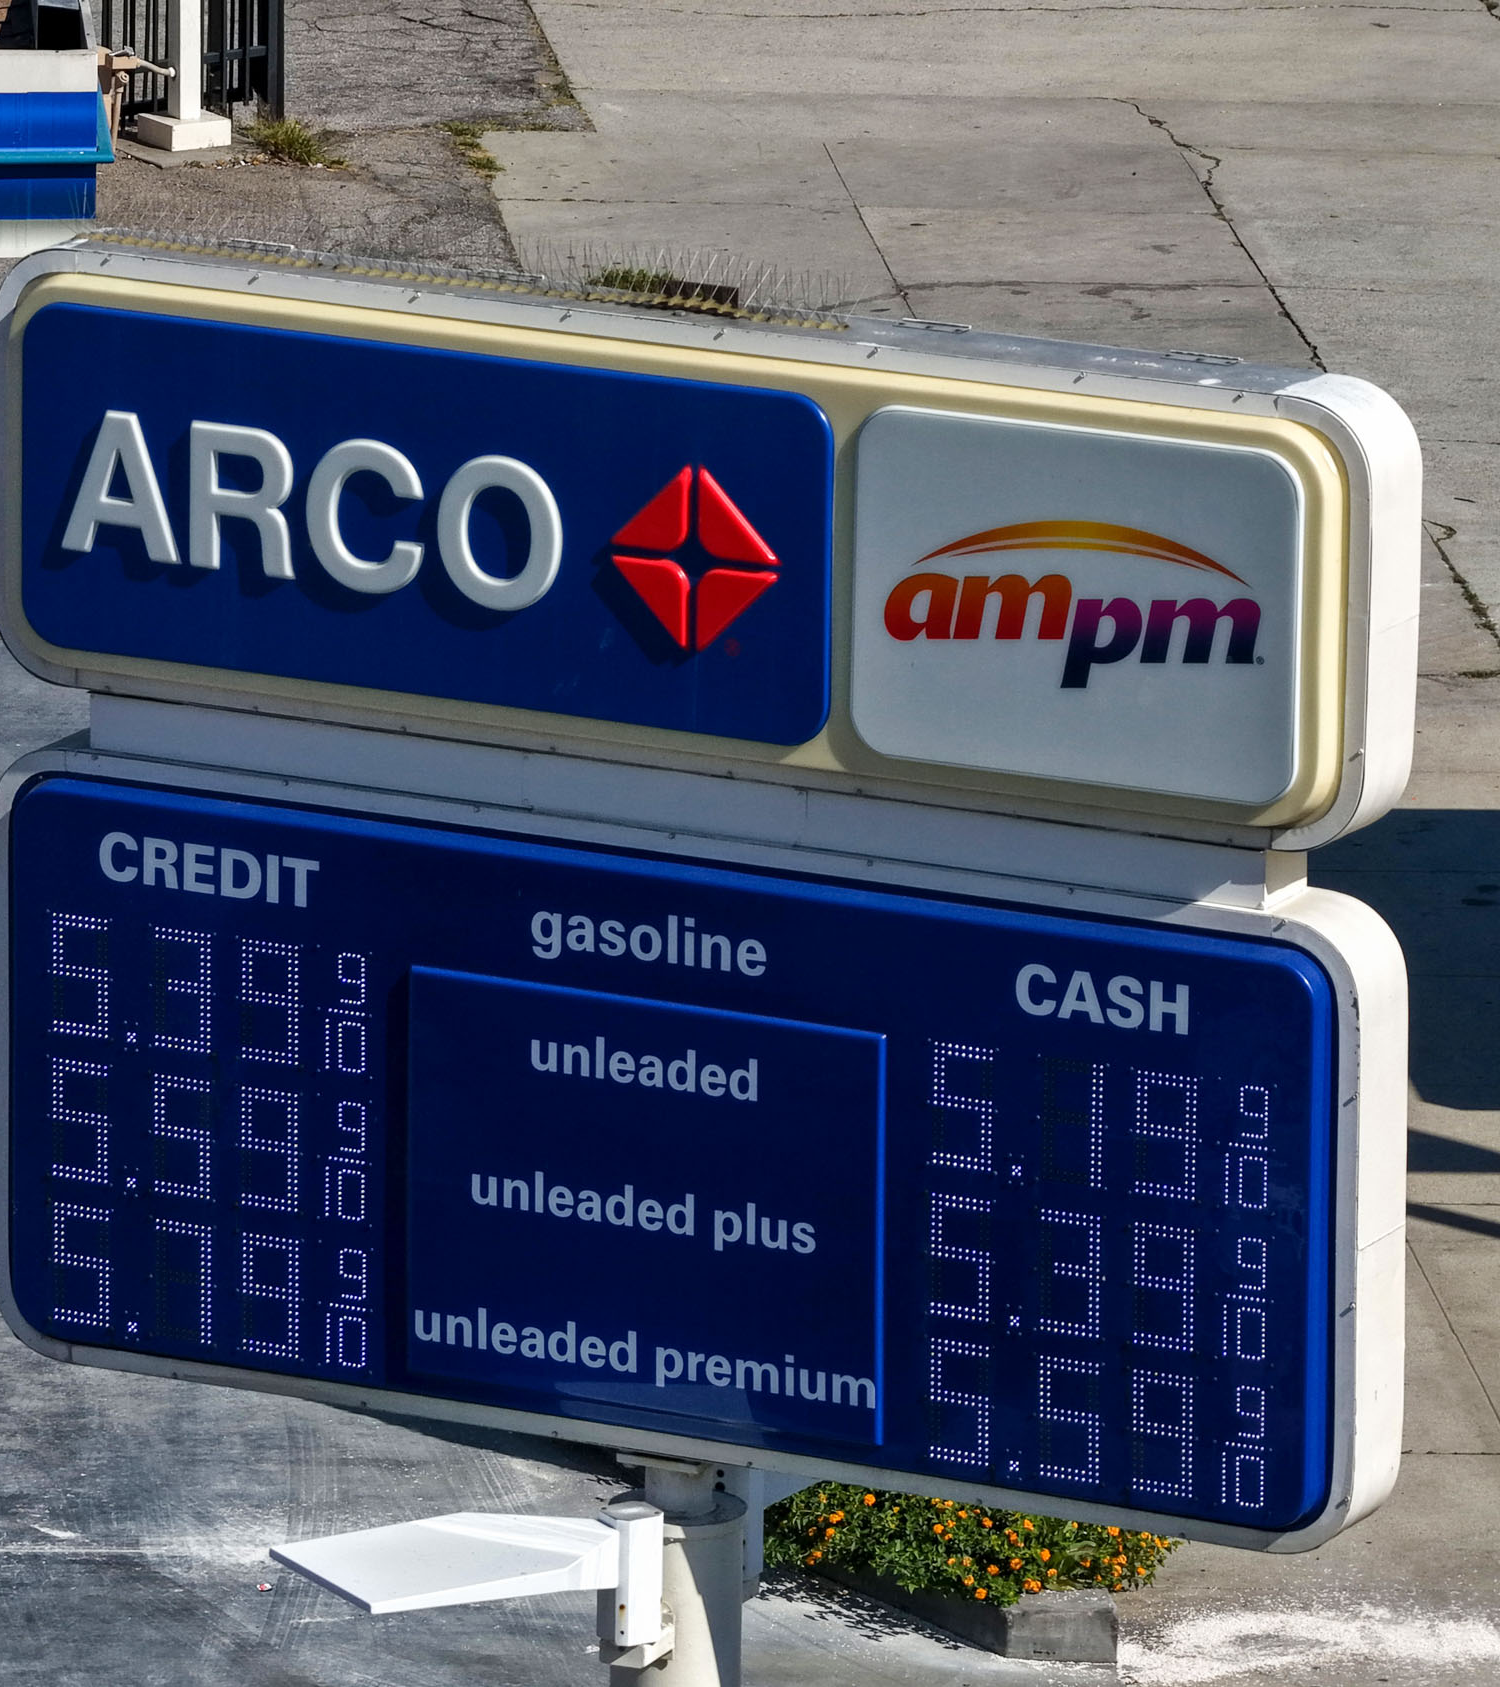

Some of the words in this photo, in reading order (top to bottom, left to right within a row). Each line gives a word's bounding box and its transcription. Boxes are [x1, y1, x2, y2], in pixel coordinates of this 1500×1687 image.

[61, 410, 563, 612] ARCO
[883, 572, 1262, 689] ampm
[99, 831, 320, 908] CREDIT
[530, 910, 767, 977] gasoline
[1015, 963, 1190, 1036] CASH
[530, 1036, 758, 1102] unleaded
[471, 1171, 695, 1236] unleaded
[713, 1202, 817, 1255] plus
[414, 1307, 638, 1374] unleaded
[655, 1345, 877, 1410] premium
